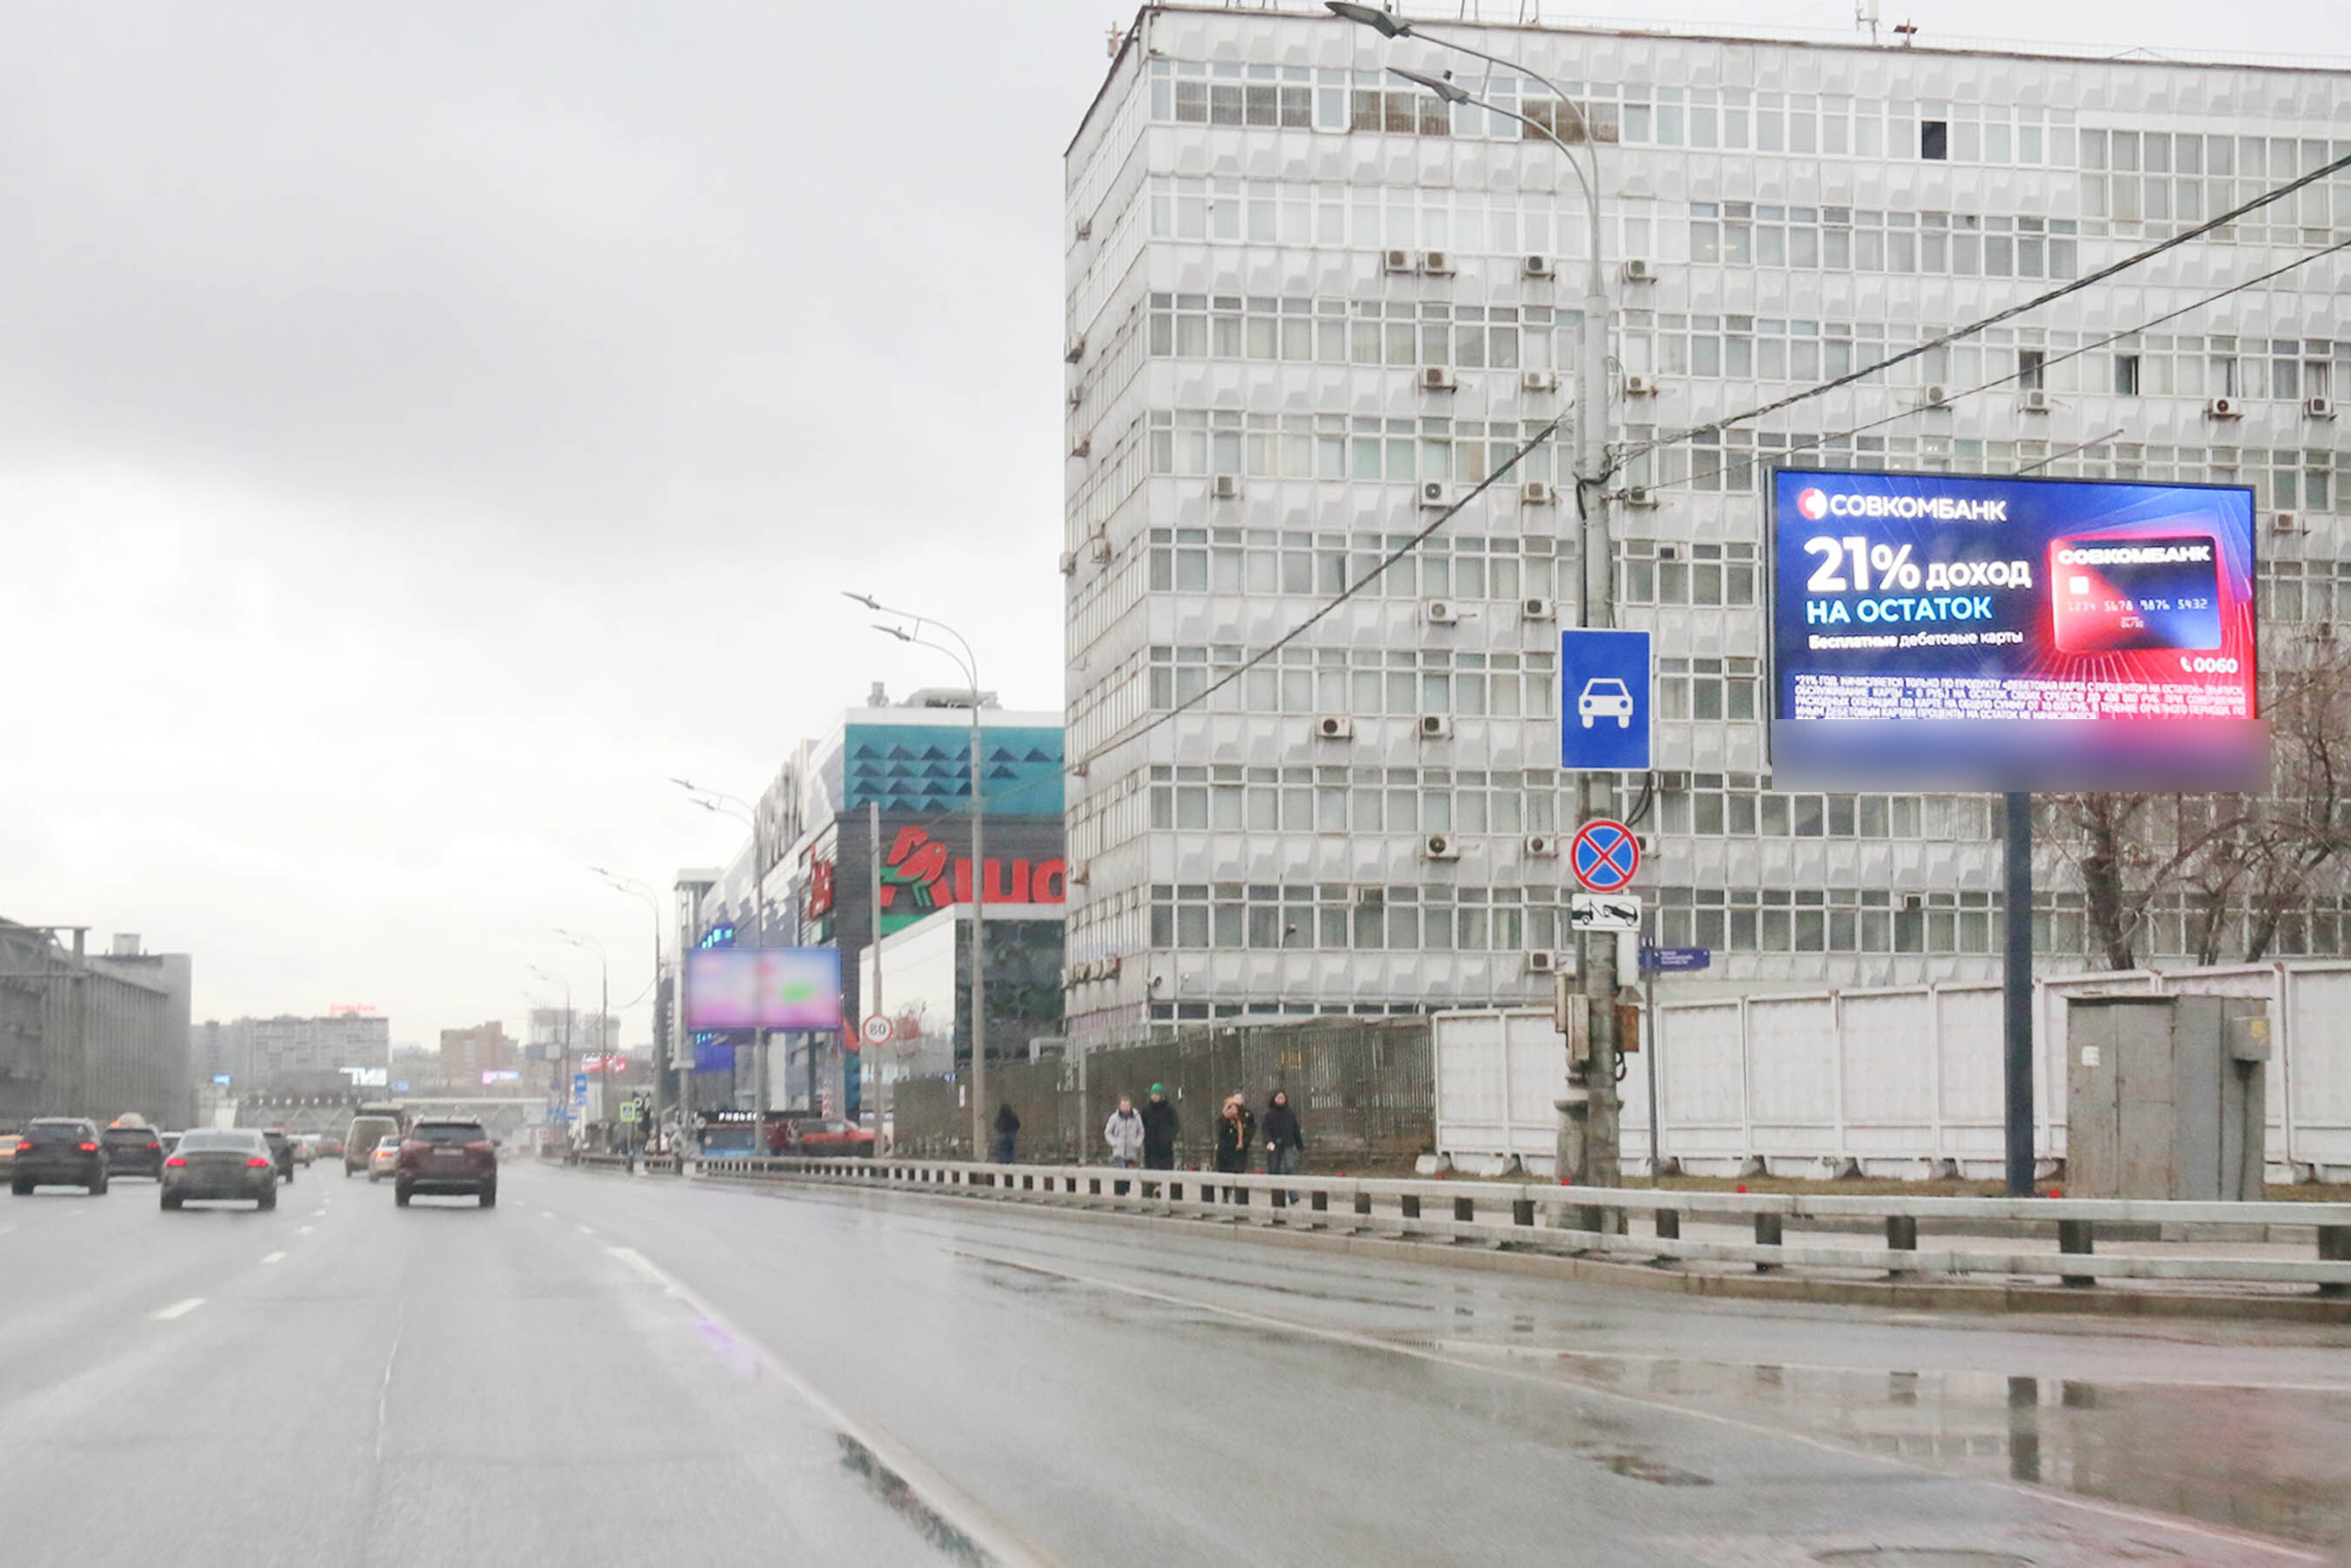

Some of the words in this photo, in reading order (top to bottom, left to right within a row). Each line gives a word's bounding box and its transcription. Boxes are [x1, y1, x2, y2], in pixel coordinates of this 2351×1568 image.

[1829, 494, 2007, 522] СОВКОМБАНК
[1803, 535, 1921, 592] 21%
[1925, 560, 2033, 591] ДОХОД
[2058, 545, 2211, 564] СОВКОМБАНК
[1806, 599, 1851, 624] НА
[1856, 596, 1993, 623] ОСТАТОК
[2104, 600, 2134, 612] 5678
[2140, 599, 2171, 611] 9876
[2177, 598, 2208, 610] 5432
[1808, 634, 1898, 650] Бесплатные
[1899, 631, 1979, 648] дебетовые
[1980, 631, 2023, 645] карты
[2193, 657, 2239, 674] 0060
